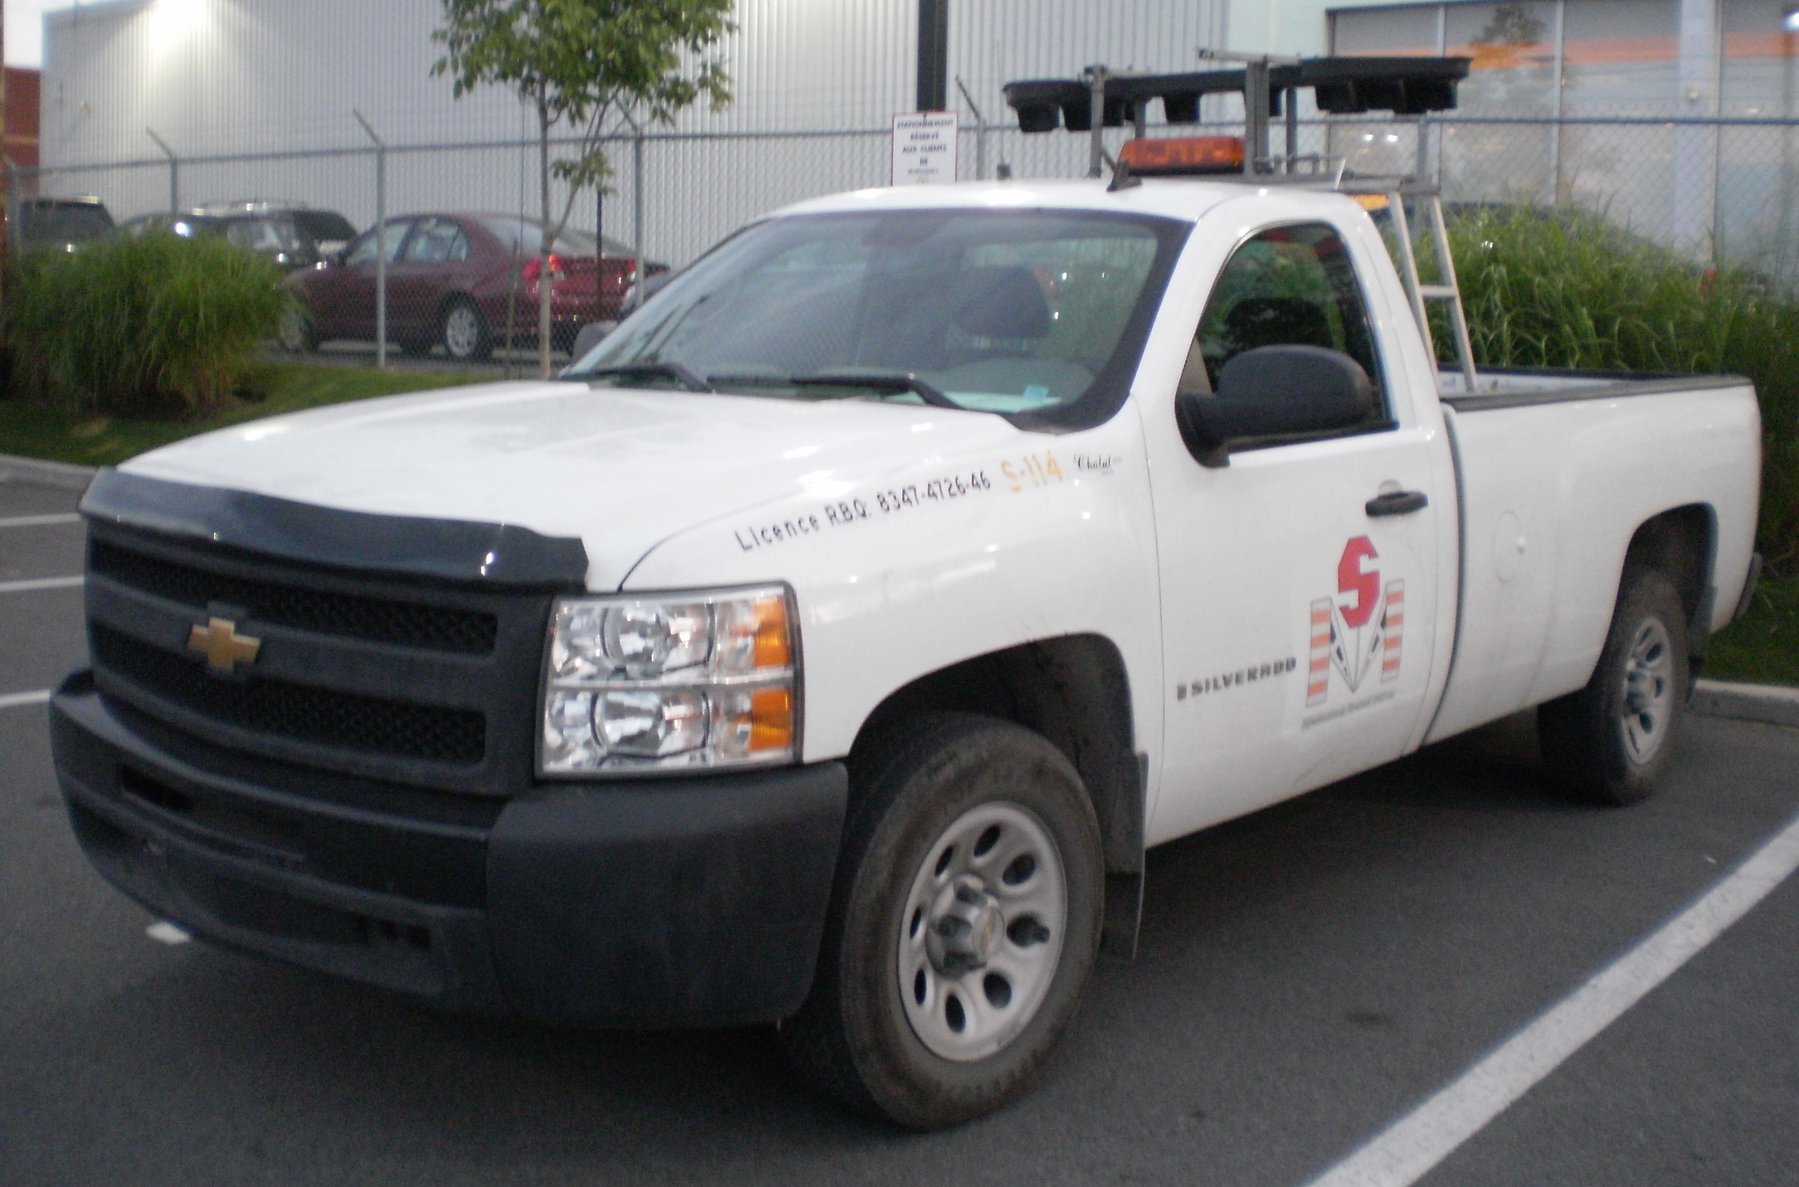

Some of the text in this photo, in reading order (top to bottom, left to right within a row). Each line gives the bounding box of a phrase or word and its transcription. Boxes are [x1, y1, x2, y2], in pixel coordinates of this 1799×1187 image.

[734, 514, 819, 551] Licence
[876, 469, 991, 514] 8347-4726-46
[1336, 534, 1381, 629] S
[1191, 656, 1297, 697] SILVERADO
